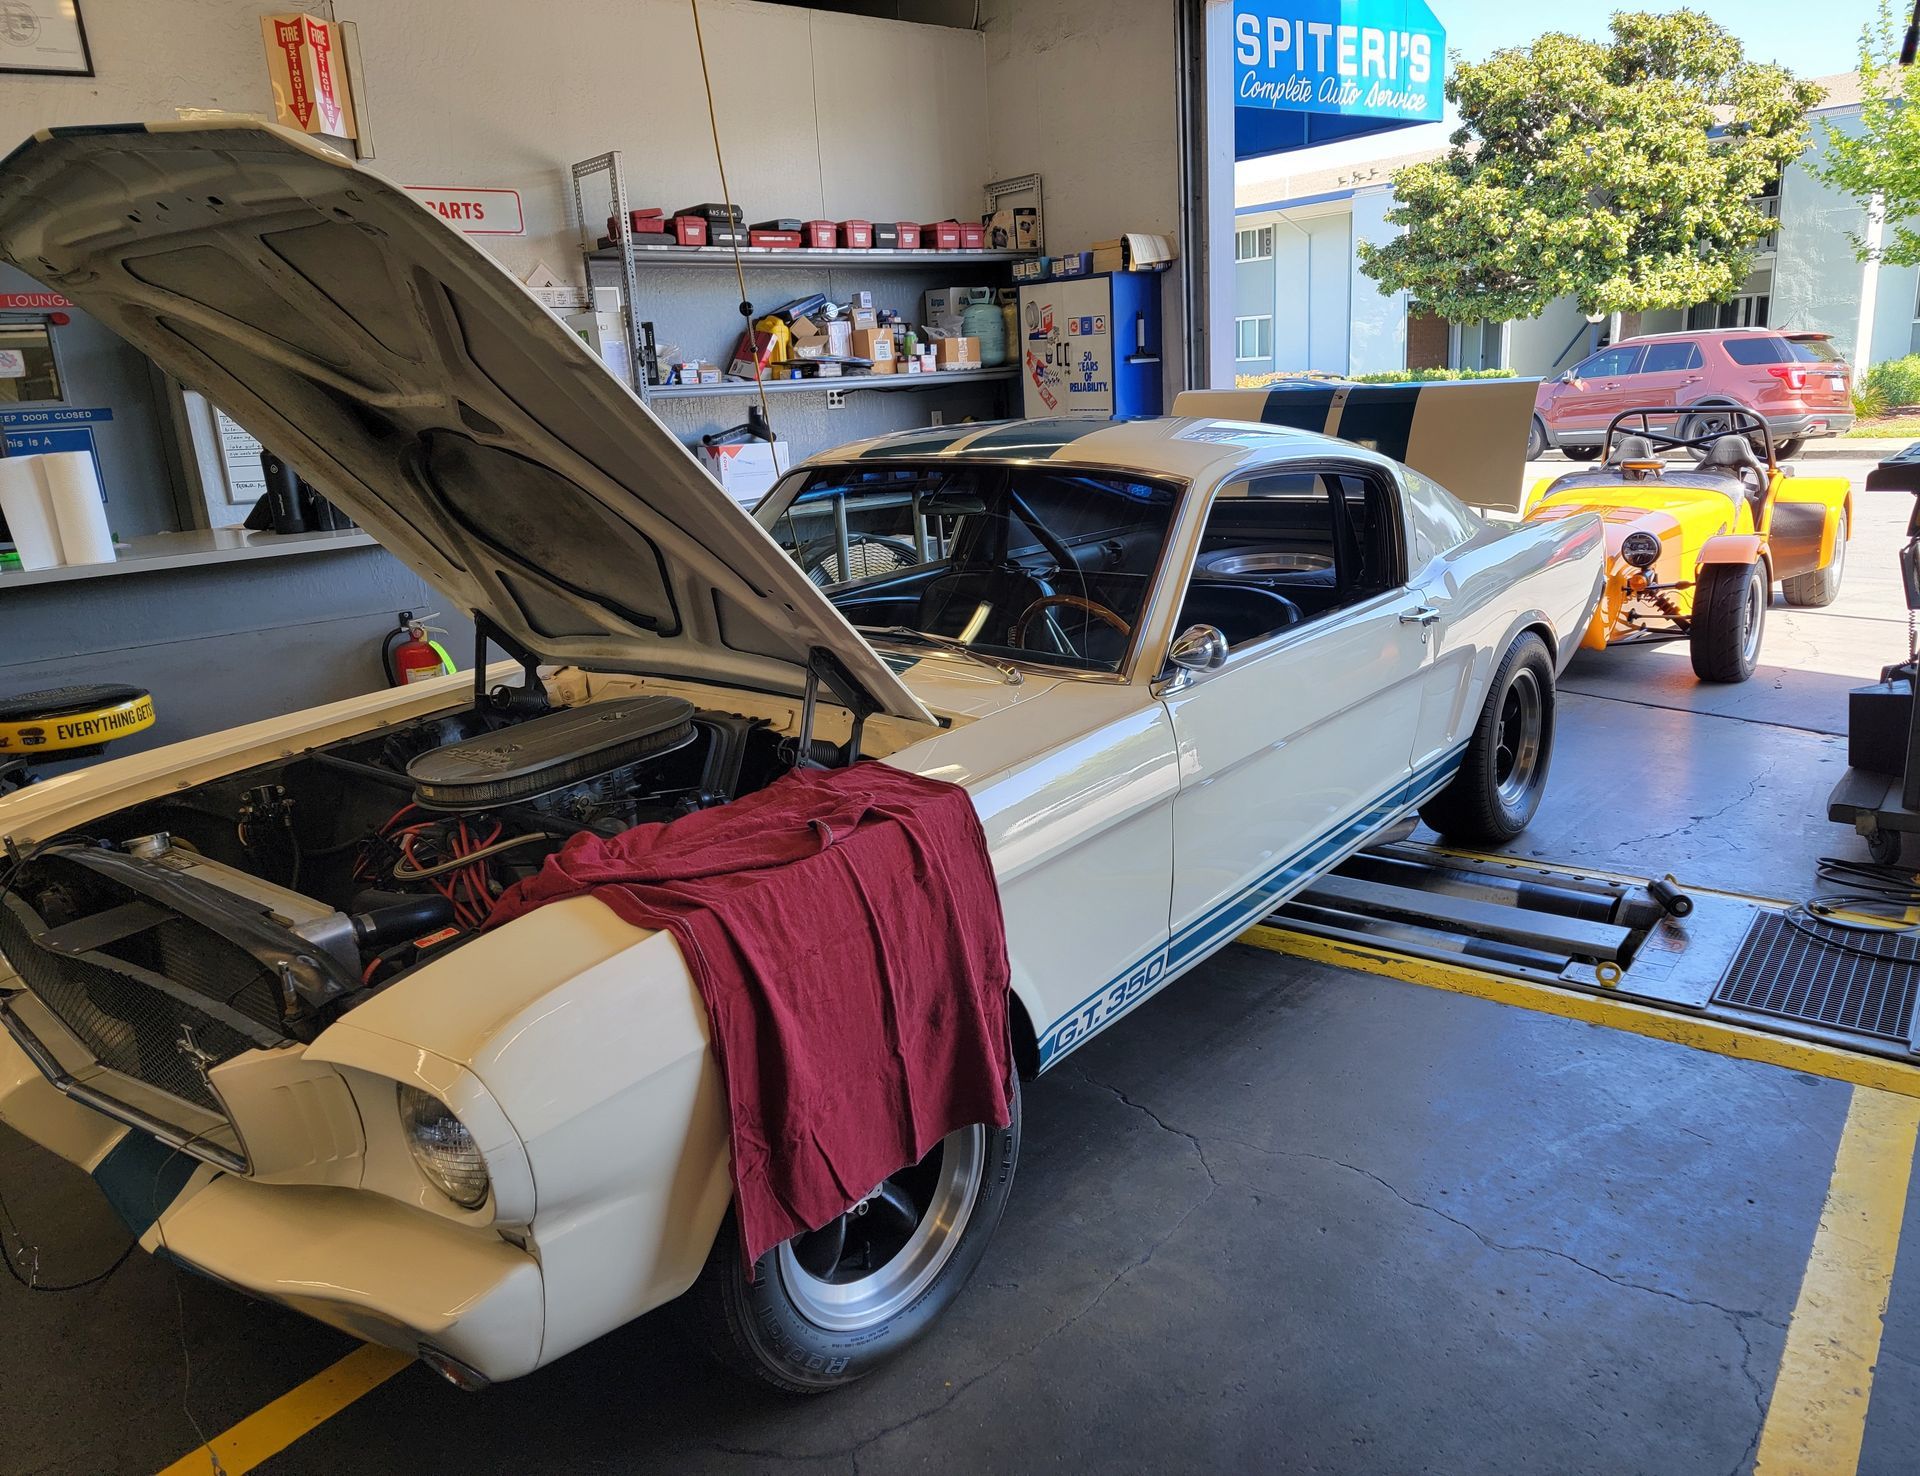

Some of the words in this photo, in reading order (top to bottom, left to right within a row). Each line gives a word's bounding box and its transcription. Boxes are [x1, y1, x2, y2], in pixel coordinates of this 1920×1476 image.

[279, 25, 300, 43] FIRE
[310, 27, 327, 46] FIRE
[1235, 12, 1431, 84] SPITERI'S
[287, 42, 309, 123] EXTINGUISHER
[316, 44, 336, 124] EXTINGUISHER
[1239, 70, 1313, 109] Complete
[1317, 76, 1362, 105] Auto
[1363, 80, 1428, 112] Service
[1083, 351, 1092, 362] 50
[1084, 372, 1093, 382] OF
[1069, 381, 1109, 393] RELIABILITY.
[0, 414, 17, 423] EEP
[22, 413, 49, 422] DOOR
[54, 411, 92, 420] CLOSED
[6, 437, 24, 448] his
[28, 436, 39, 447] Is
[43, 435, 52, 446] A
[56, 709, 136, 740] EVERYTHING
[1053, 999, 1103, 1055] G.T.
[1105, 952, 1166, 1015] 350
